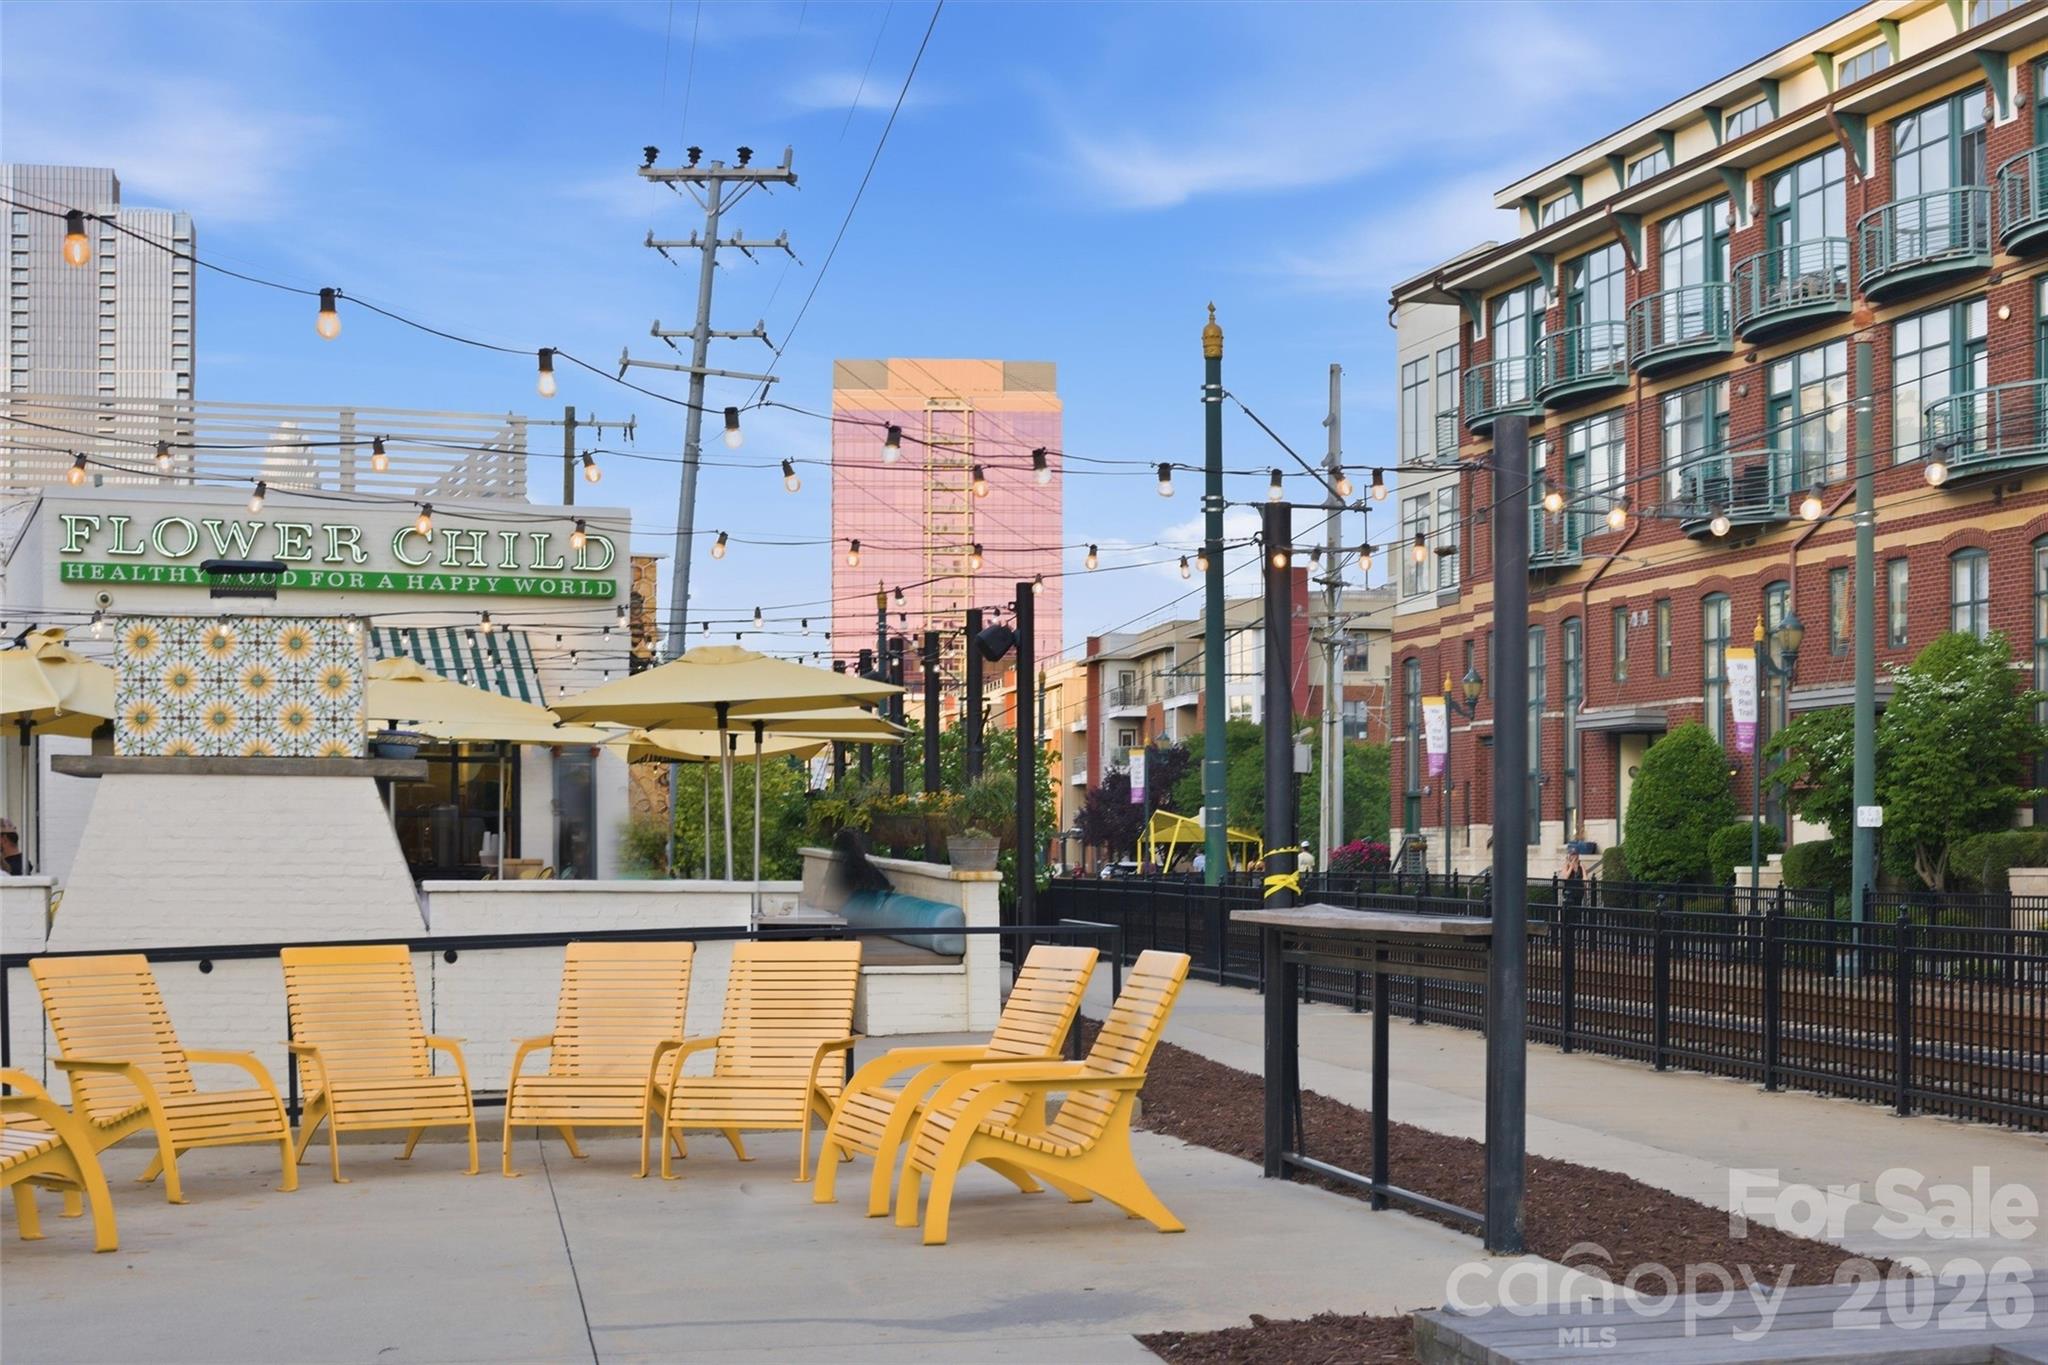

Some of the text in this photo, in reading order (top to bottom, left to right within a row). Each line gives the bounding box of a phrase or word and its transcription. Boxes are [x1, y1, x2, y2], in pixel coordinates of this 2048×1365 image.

[60, 514, 616, 572] FLOWER CHILD
[65, 563, 206, 583] HEALTHY
[310, 571, 366, 588] FOR
[377, 575, 394, 589] A
[407, 575, 500, 592] HAPPY
[513, 577, 613, 596] WORLD
